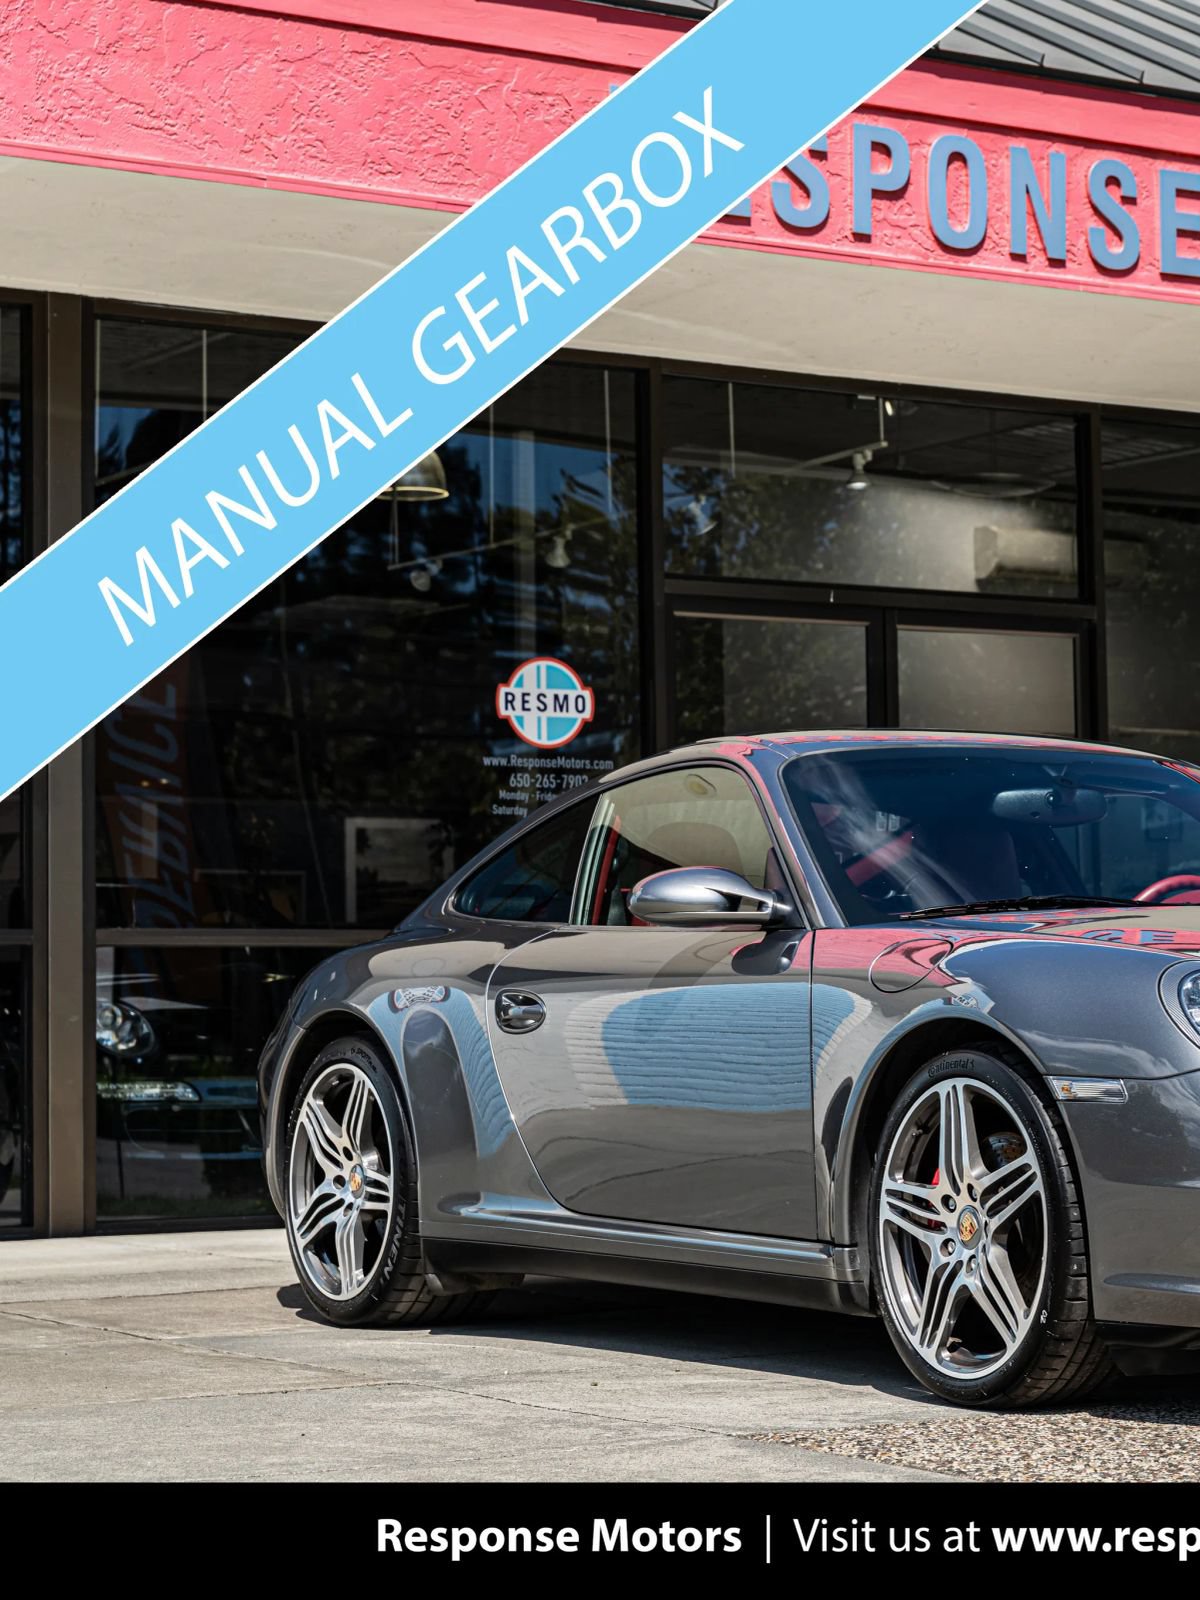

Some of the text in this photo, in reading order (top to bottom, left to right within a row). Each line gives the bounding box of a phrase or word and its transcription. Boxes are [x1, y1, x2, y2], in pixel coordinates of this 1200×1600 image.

[504, 691, 587, 714] RESMO
[482, 754, 614, 770] www.ResponseMotors.com
[498, 789, 529, 803] Monday
[491, 804, 528, 817] Saturday
[928, 1059, 969, 1078] Continental
